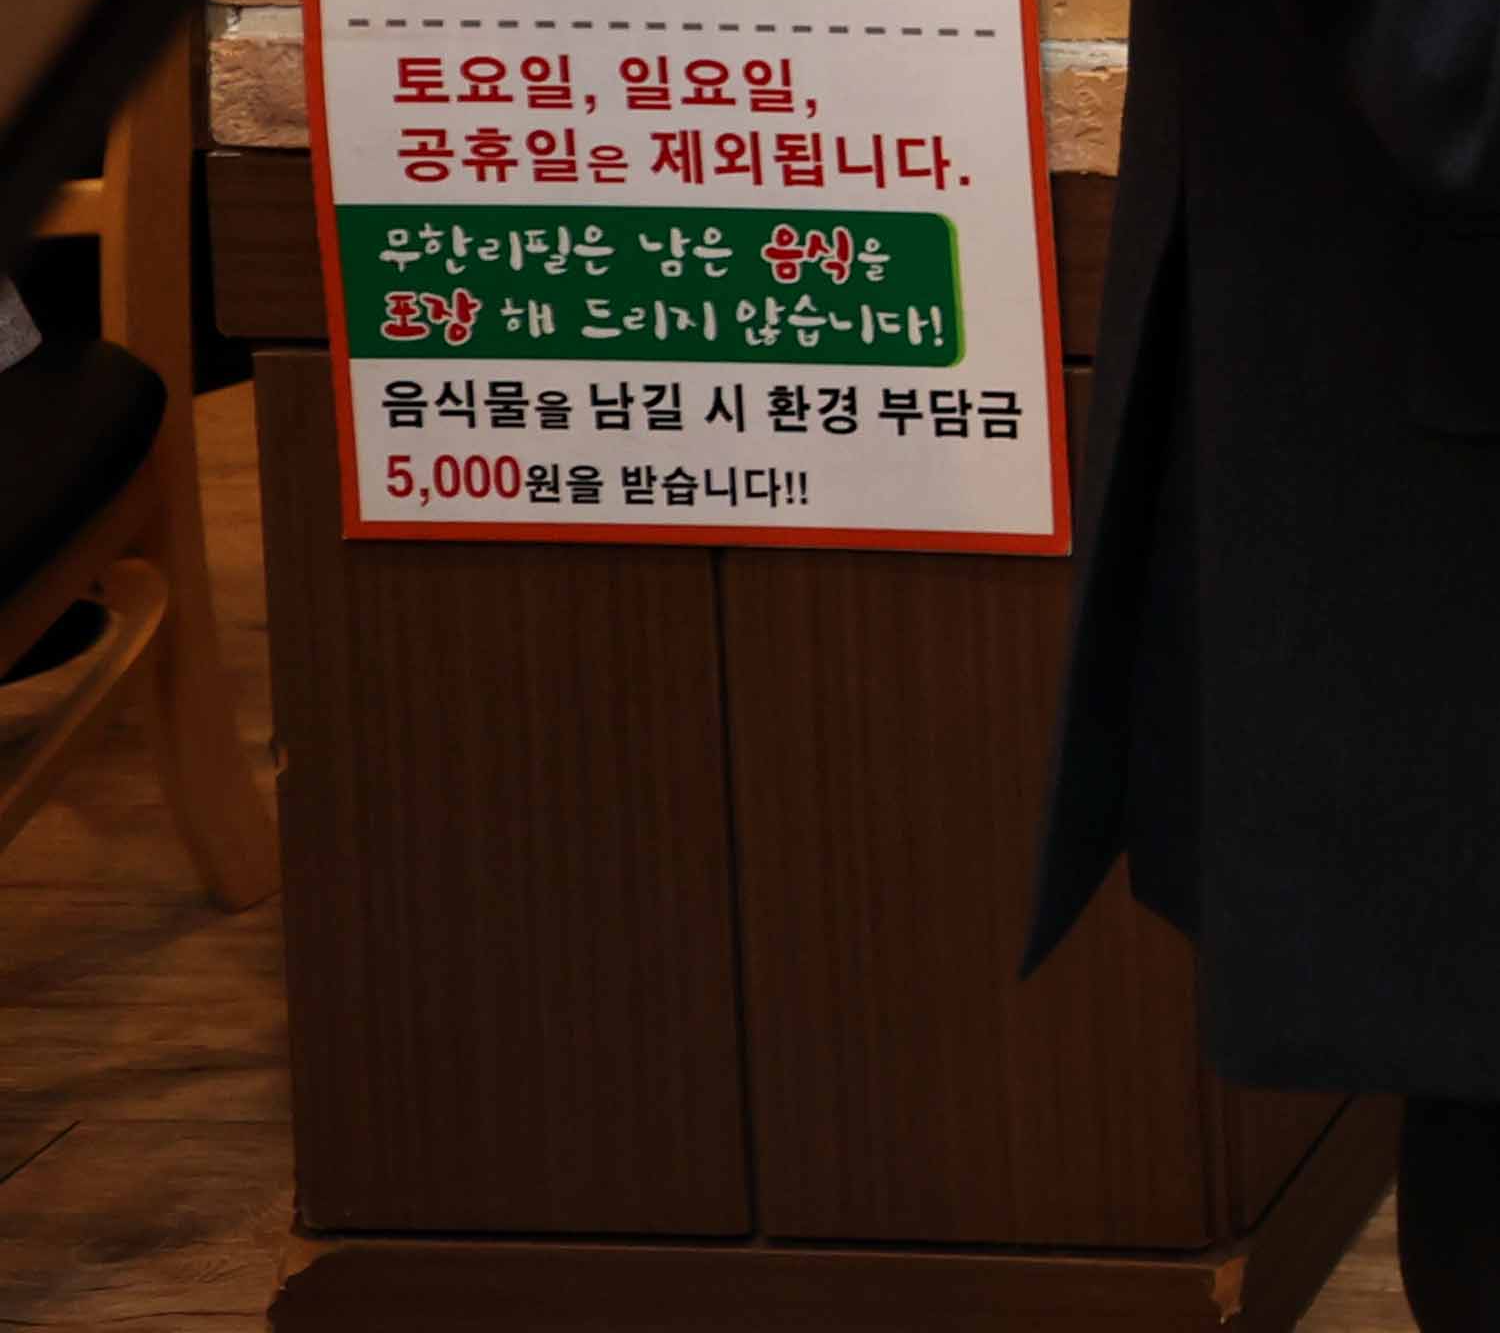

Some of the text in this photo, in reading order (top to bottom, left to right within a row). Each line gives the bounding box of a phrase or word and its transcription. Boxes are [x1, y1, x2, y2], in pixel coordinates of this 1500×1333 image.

[392, 53, 819, 119] 토요일, 일요일,
[397, 128, 972, 190] 공휴일은 제외됩니다.
[378, 222, 892, 286] 무한리필은 남은 음식을
[380, 288, 944, 348] 포장 해 드리지 않습니다!
[381, 380, 1024, 441] 음식물을 남길 시 환경 부담금
[385, 453, 810, 508] 5,000원을 받습니다!!
